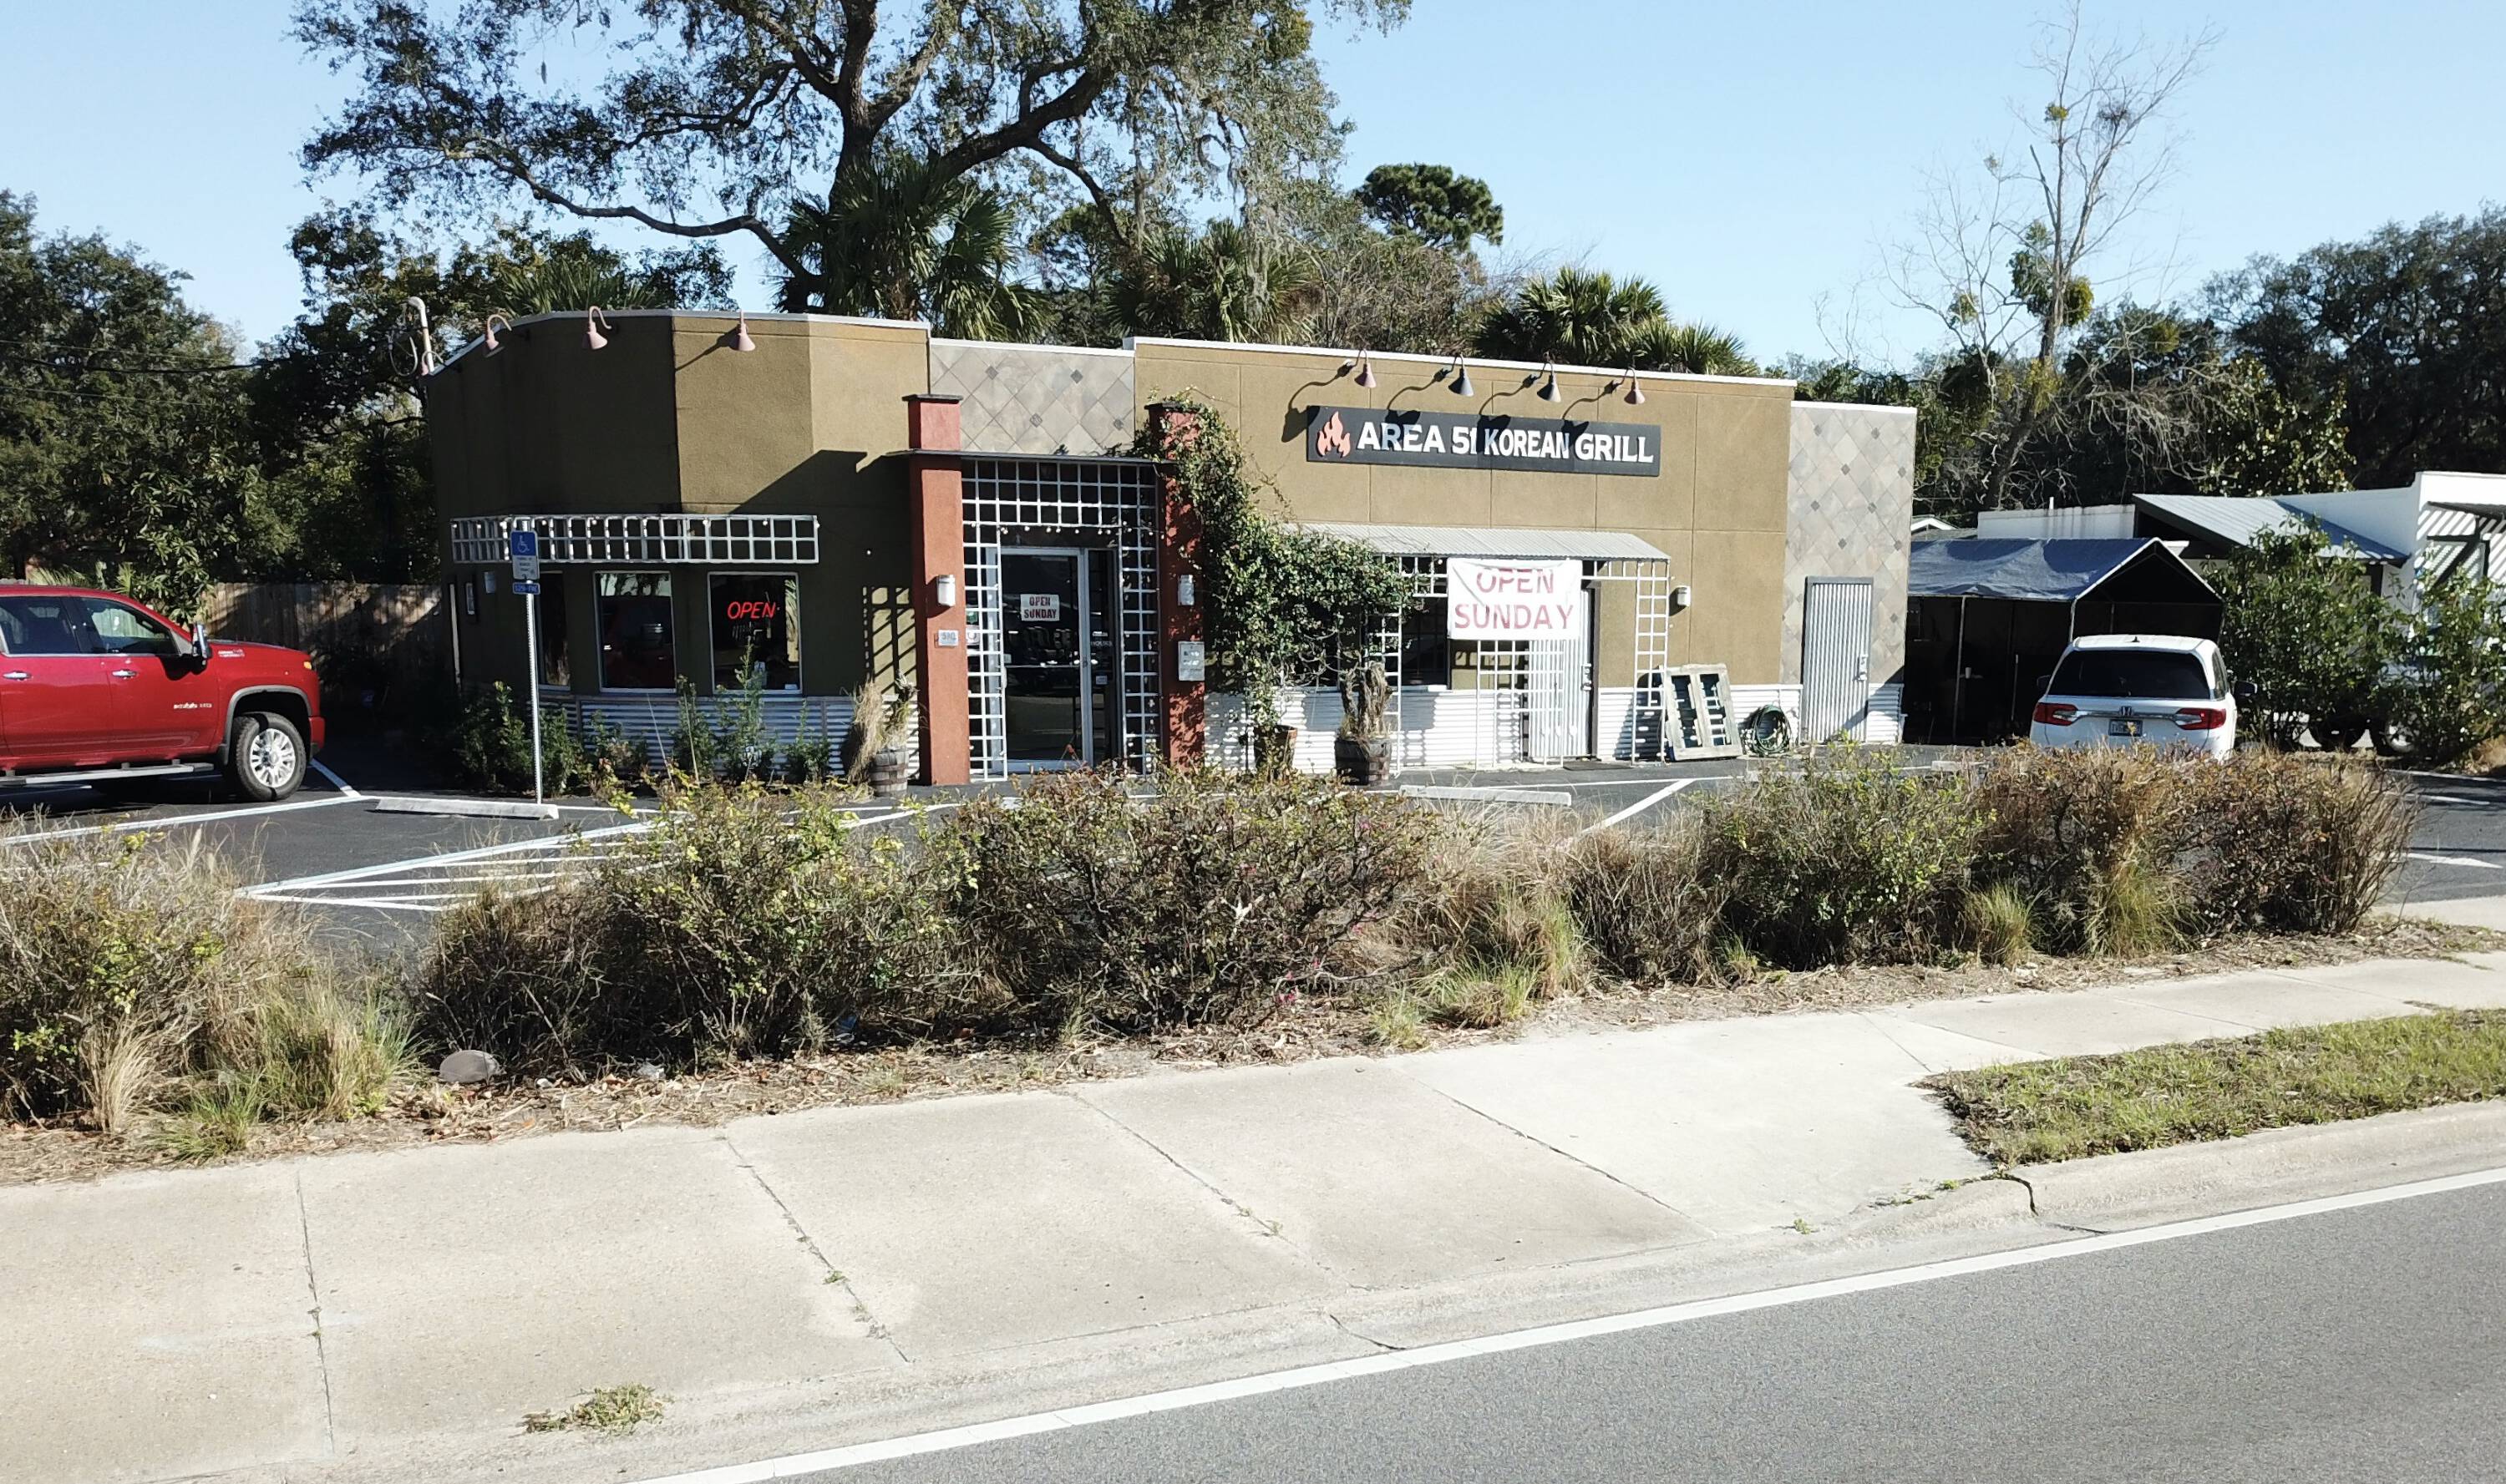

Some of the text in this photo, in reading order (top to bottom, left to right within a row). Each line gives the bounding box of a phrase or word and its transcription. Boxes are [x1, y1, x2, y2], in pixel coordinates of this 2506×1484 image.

[1357, 421, 1654, 463] AREA 51 KOREAN GRILL
[1476, 567, 1555, 594] OPEN
[727, 601, 776, 620] OPEN
[1028, 596, 1051, 606] OPEN
[1023, 609, 1057, 619] SUNDAY
[1454, 603, 1575, 629] SUNDAY
